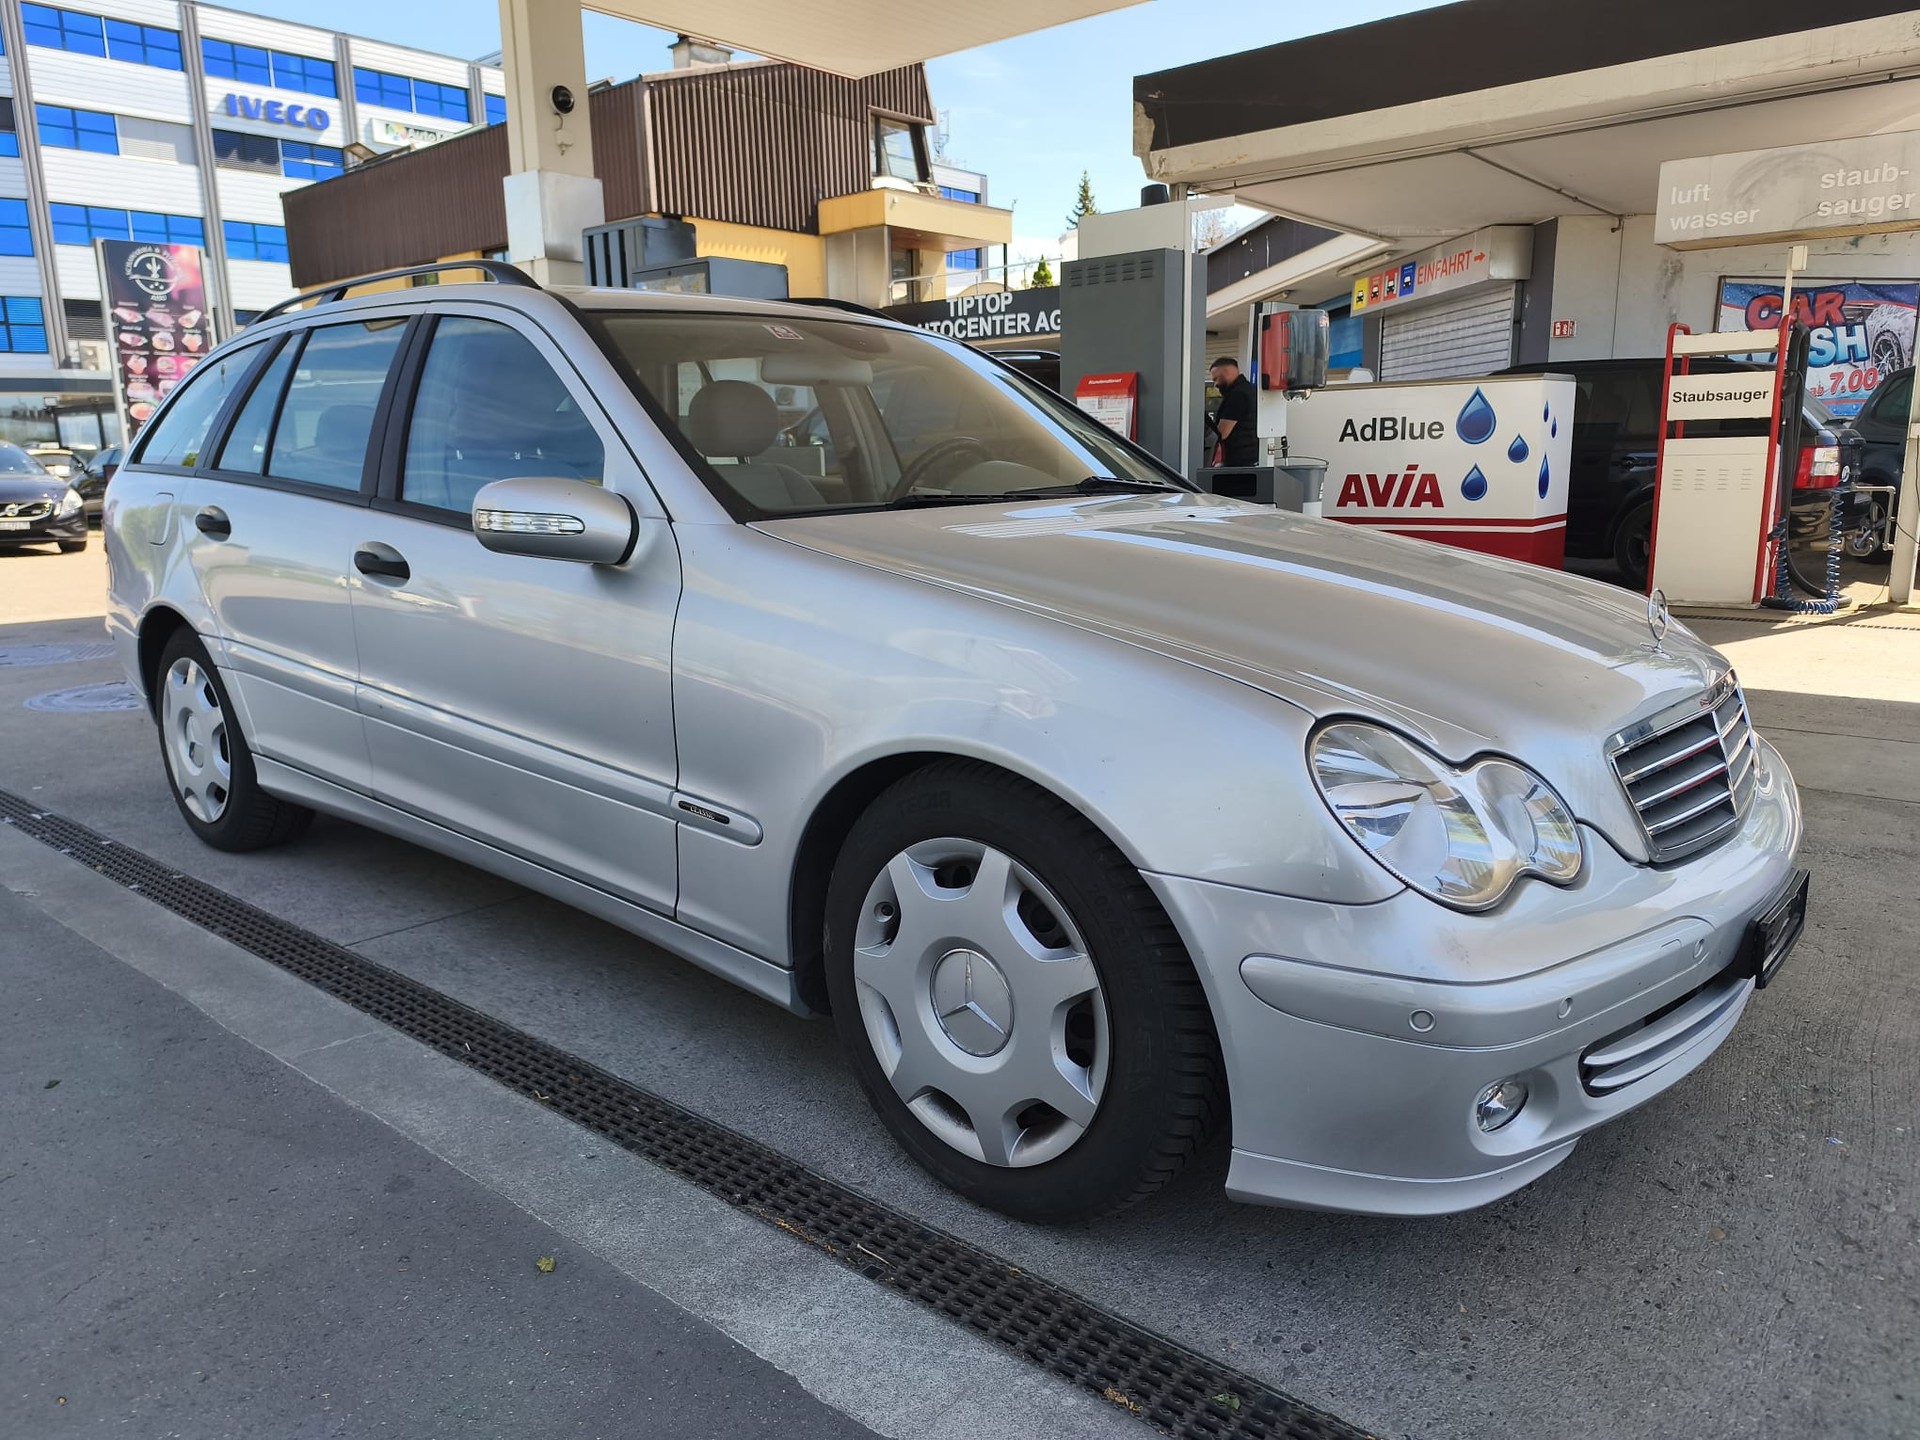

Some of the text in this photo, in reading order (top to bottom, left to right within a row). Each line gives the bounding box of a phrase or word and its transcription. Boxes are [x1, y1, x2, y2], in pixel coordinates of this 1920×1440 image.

[226, 94, 330, 131] IVECO
[1820, 163, 1909, 189] staub-
[1671, 184, 1711, 205] luft
[1817, 191, 1916, 217] sauger
[1670, 207, 1760, 231] wasser
[1416, 249, 1473, 286] EINFAHRT
[946, 292, 1013, 317] TIPTOP
[1745, 290, 1847, 331] CAR
[917, 309, 1061, 339] TOCENTER AG
[1672, 390, 1769, 403] Staubsauger
[1810, 384, 1825, 397] ab
[1338, 416, 1445, 443] AdBlue
[690, 805, 715, 820] CLASSIC
